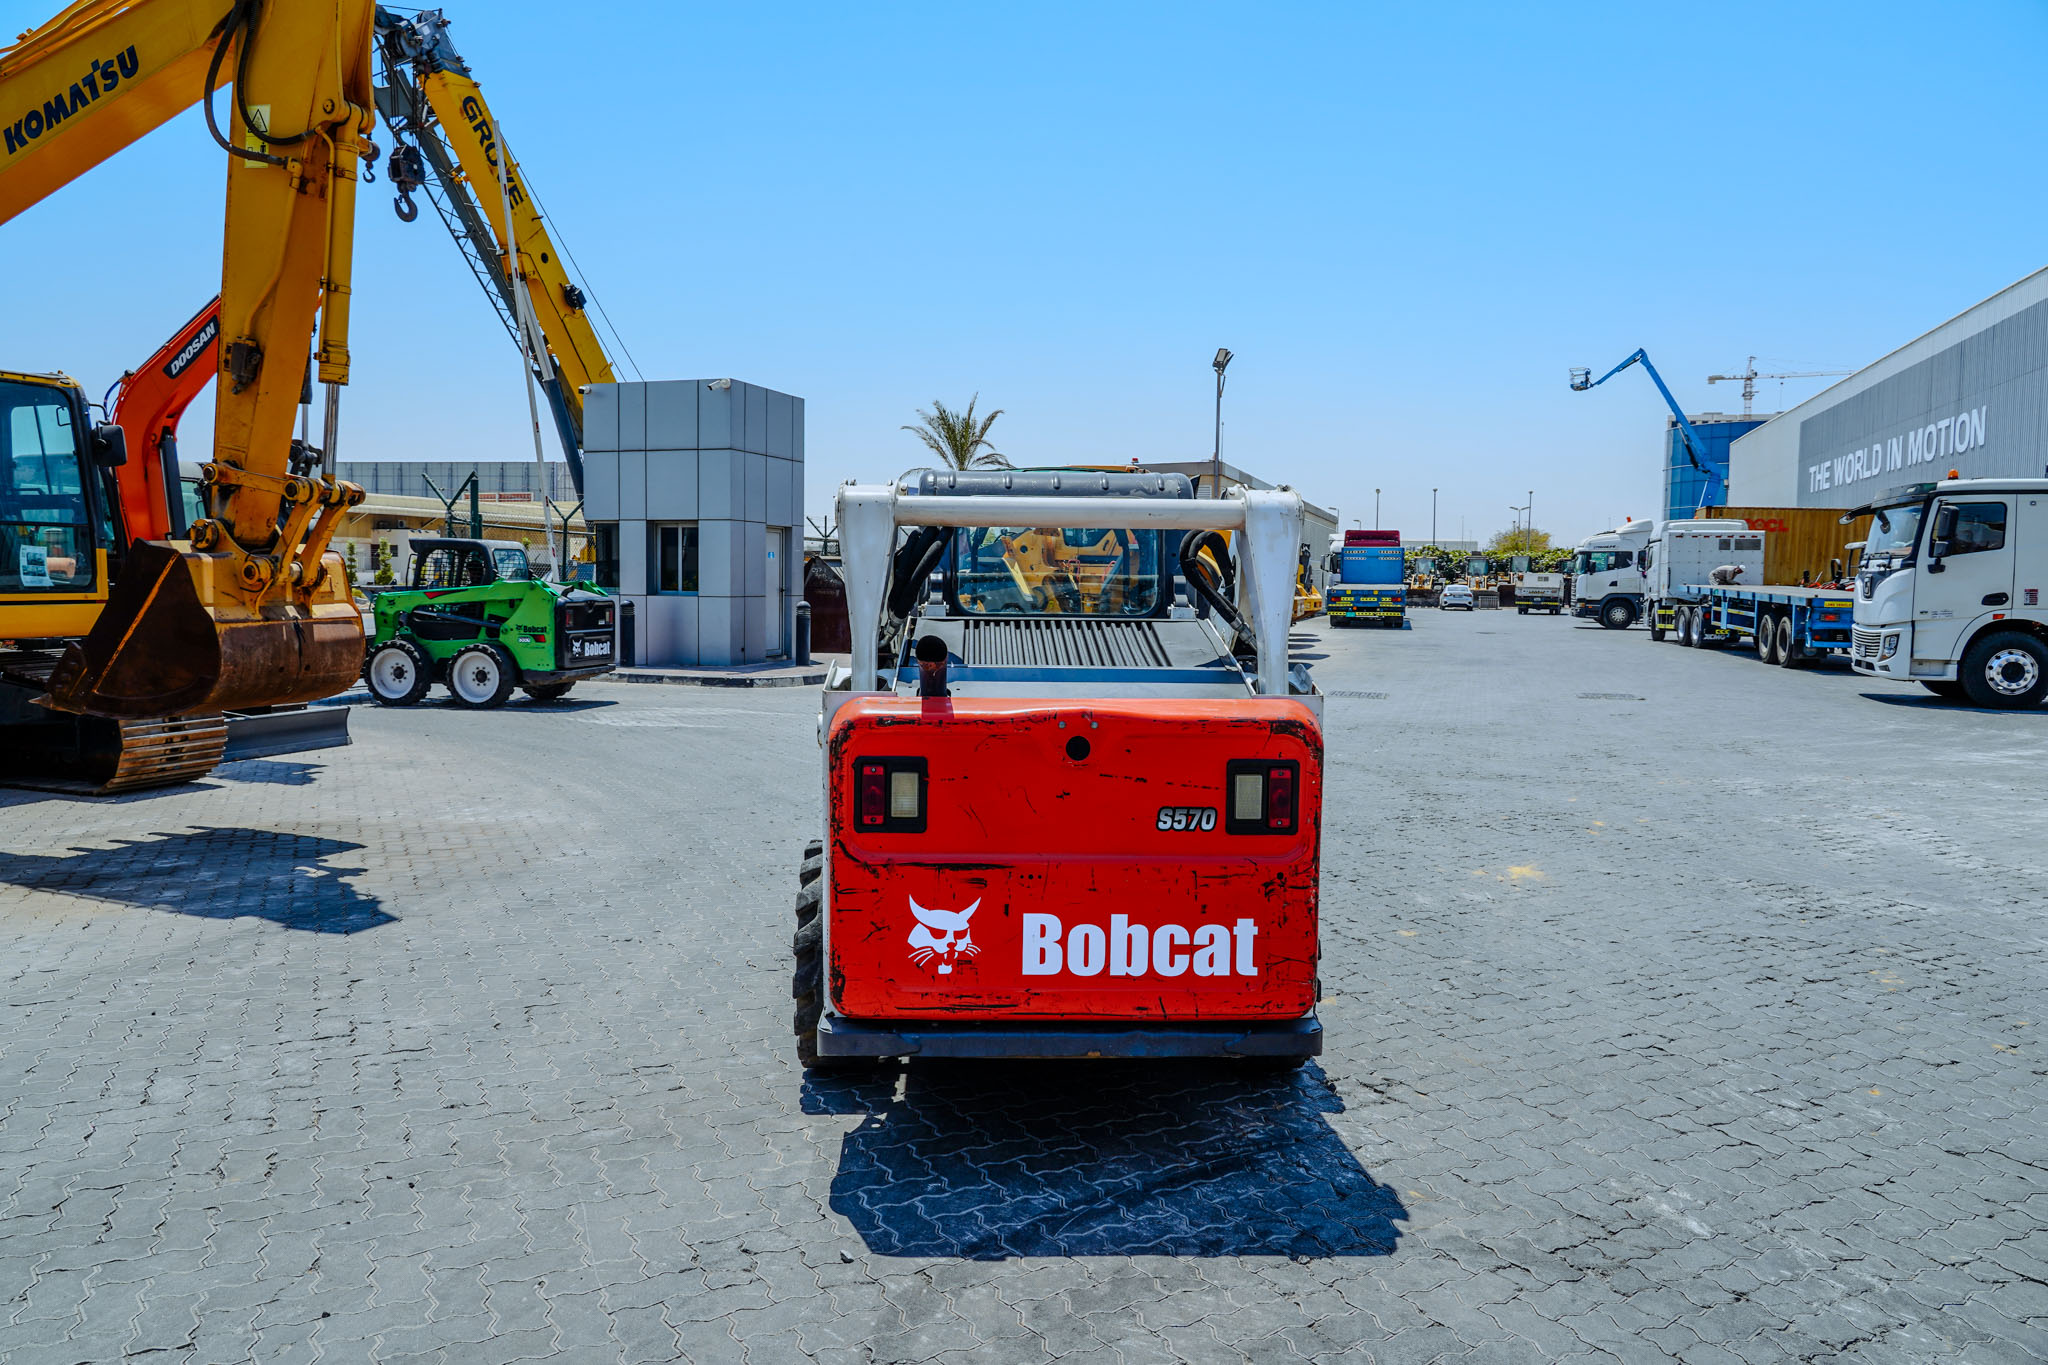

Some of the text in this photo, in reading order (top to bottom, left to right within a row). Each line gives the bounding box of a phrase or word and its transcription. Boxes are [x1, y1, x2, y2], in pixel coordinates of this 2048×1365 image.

[3, 45, 139, 155] KOMATSU
[171, 322, 215, 375] DOOSAN
[1809, 405, 1987, 493] THE WORLD IN MOTION
[523, 625, 547, 633] Bobcat
[584, 641, 611, 657] Bobcat
[1157, 807, 1217, 831] S570
[1022, 912, 1258, 977] Bobcat
